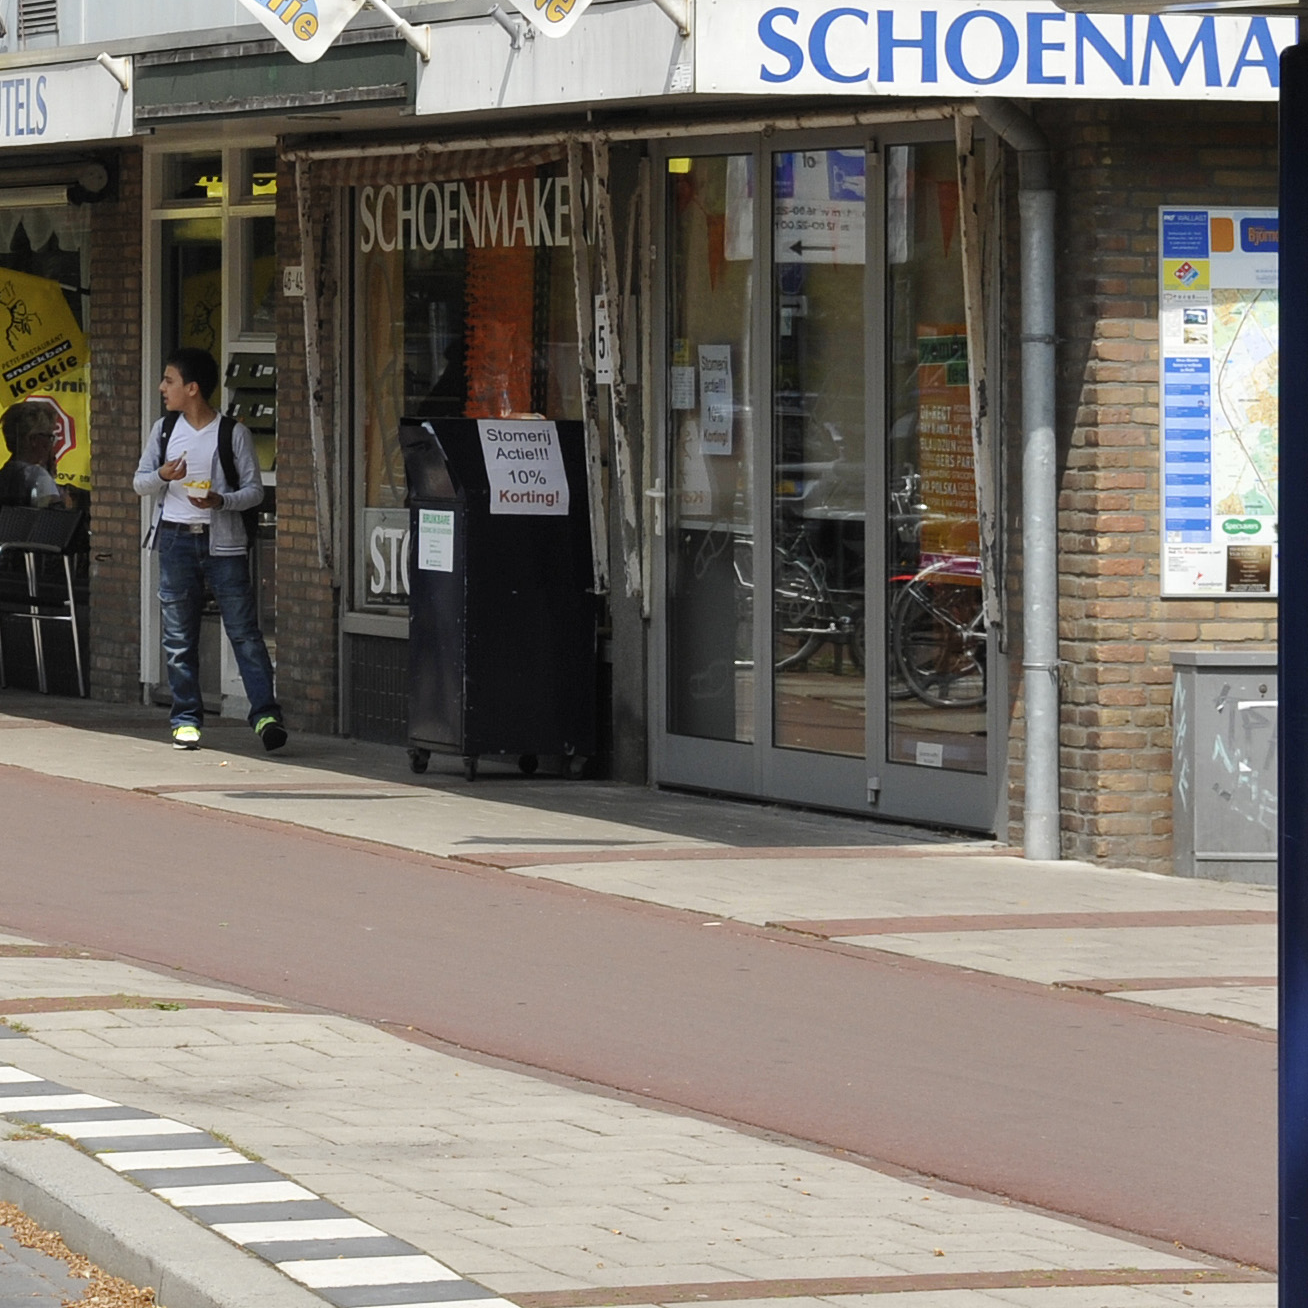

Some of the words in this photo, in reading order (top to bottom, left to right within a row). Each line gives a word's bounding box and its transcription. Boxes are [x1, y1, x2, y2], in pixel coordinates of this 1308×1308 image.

[757, 7, 1281, 88] SCHOENMA
[1, 333, 64, 370] PETIT-RESTAURANT
[4, 343, 69, 379] snackbar
[9, 354, 78, 398] Kockie
[486, 428, 552, 445] Stomerij
[496, 447, 549, 460] Actie!!!
[508, 470, 547, 485] 10%
[499, 489, 559, 507] Korting!
